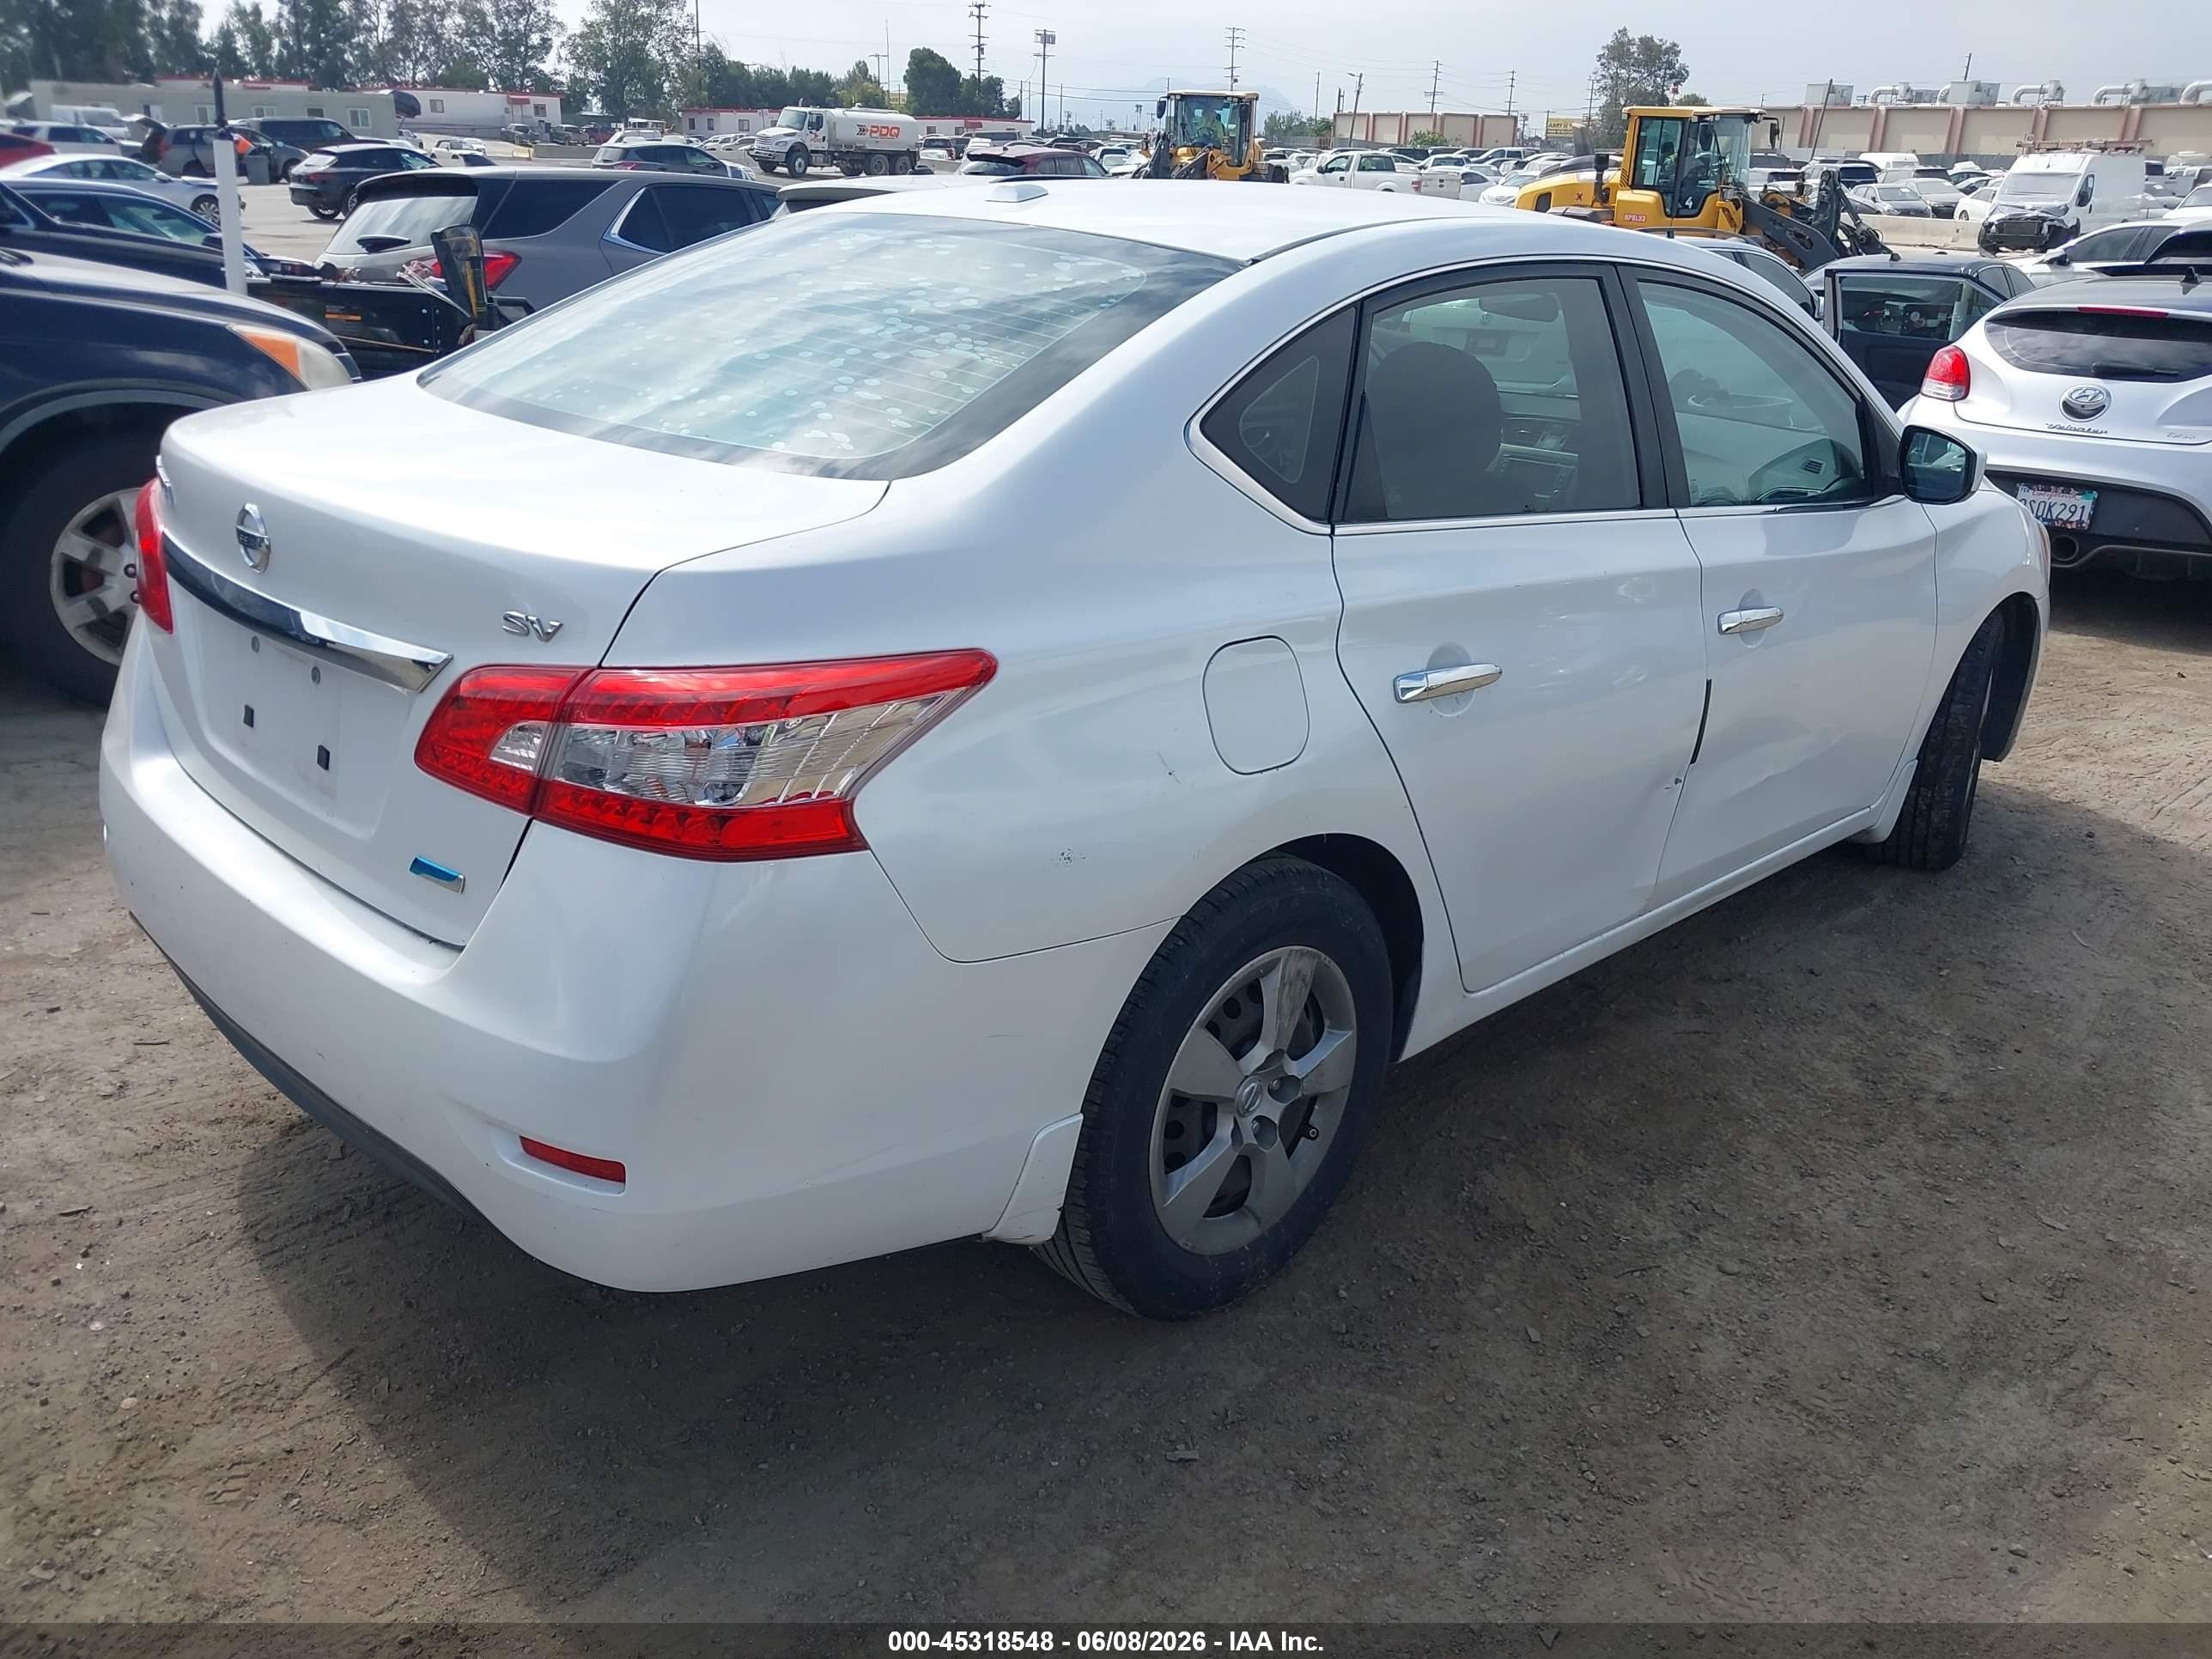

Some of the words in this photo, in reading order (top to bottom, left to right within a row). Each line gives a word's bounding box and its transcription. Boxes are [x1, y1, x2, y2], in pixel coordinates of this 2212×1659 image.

[869, 125, 900, 139] PDQ
[1685, 196, 1693, 209] 4
[501, 611, 563, 642] SV
